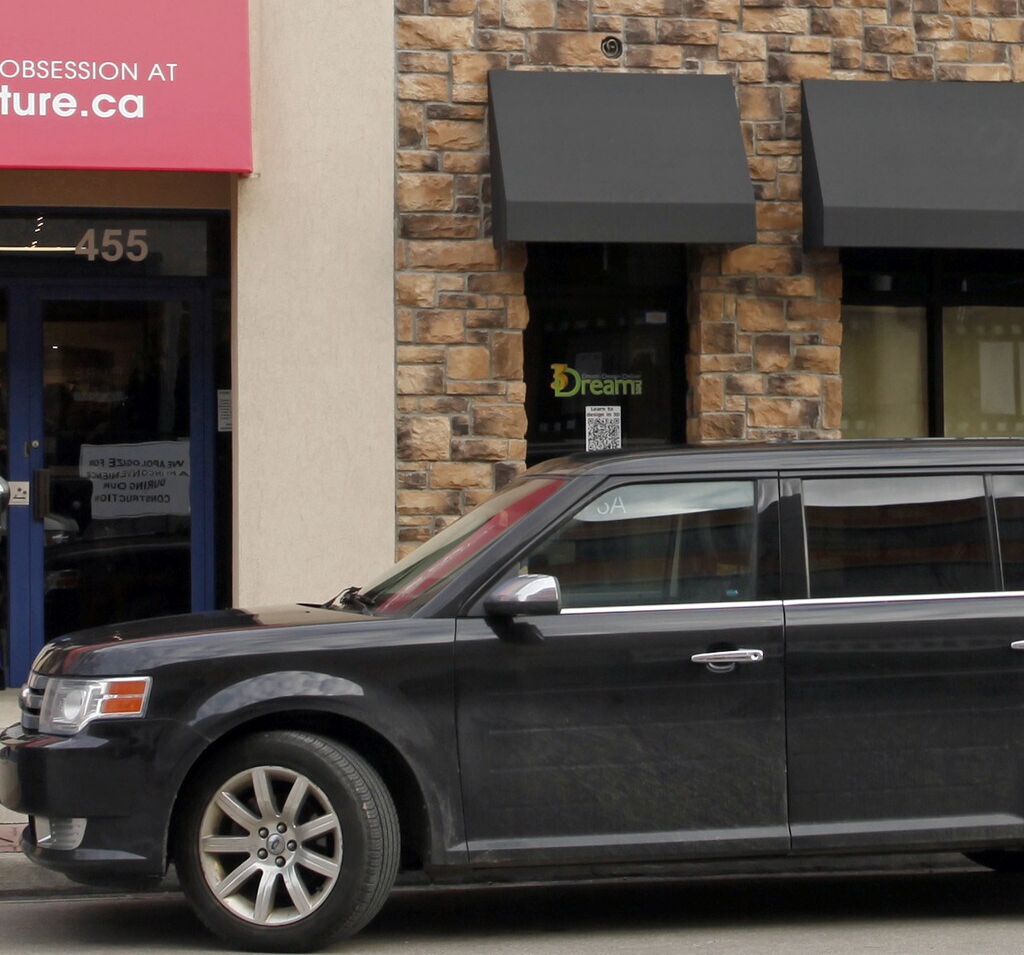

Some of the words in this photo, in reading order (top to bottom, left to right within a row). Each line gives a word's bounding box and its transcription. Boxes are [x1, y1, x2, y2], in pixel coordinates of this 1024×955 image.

[0, 59, 138, 81] OBSESSION
[147, 63, 178, 82] AT
[0, 85, 144, 118] ture.ca
[75, 228, 149, 262] 455
